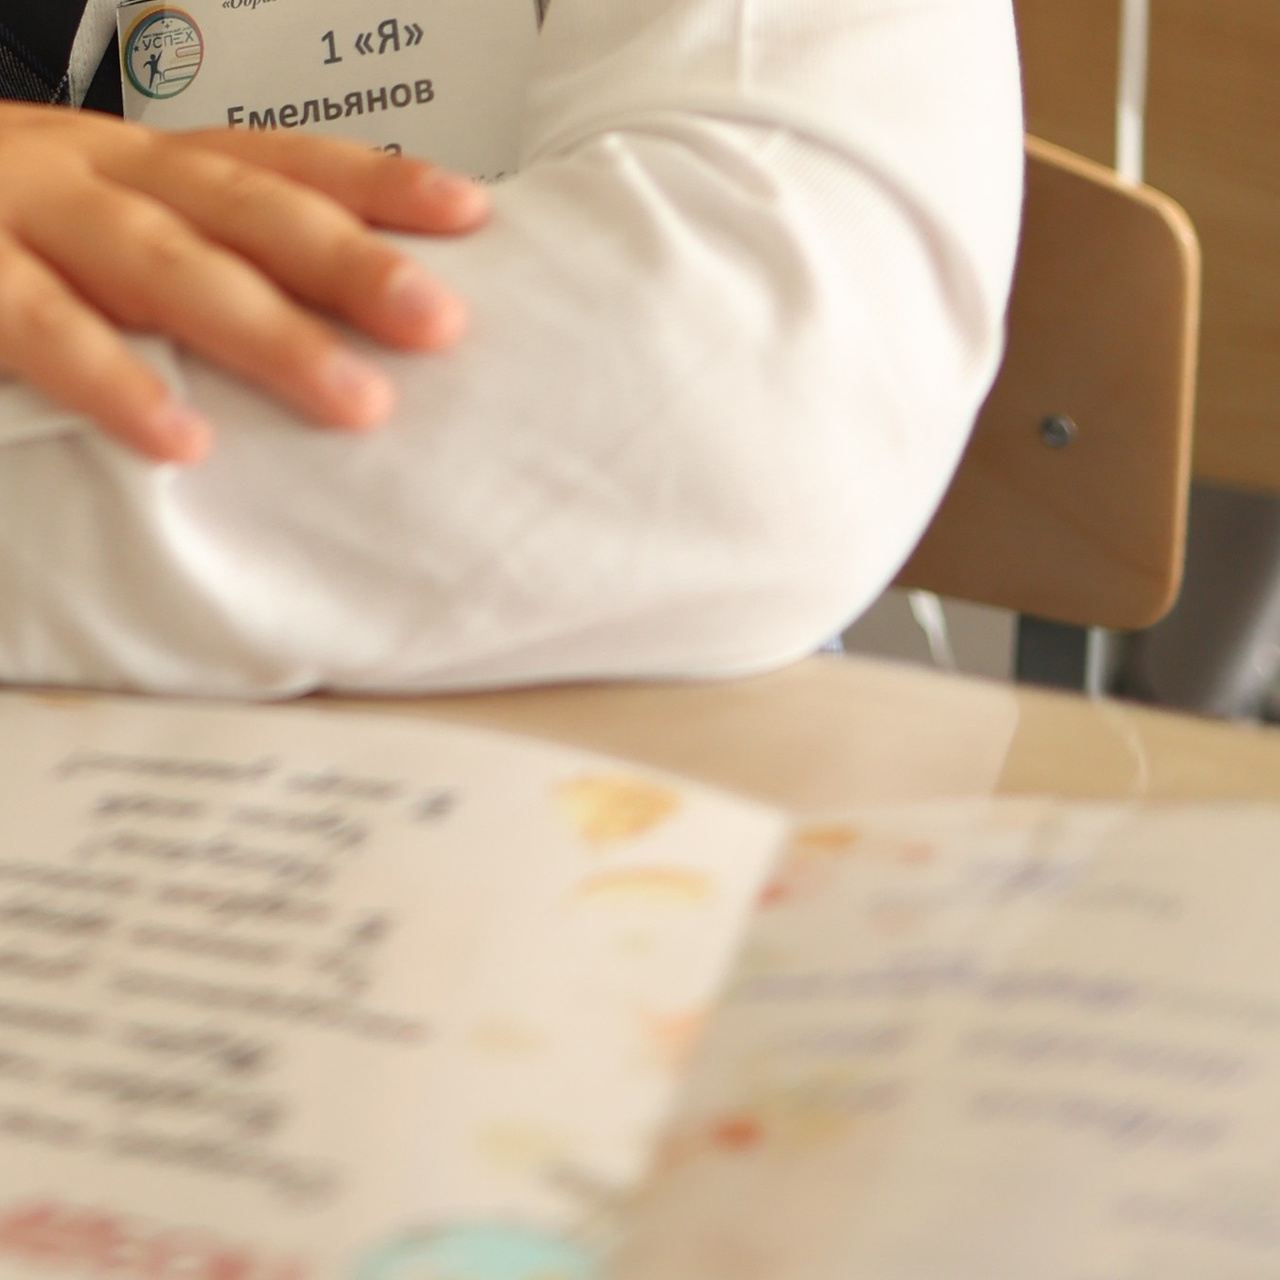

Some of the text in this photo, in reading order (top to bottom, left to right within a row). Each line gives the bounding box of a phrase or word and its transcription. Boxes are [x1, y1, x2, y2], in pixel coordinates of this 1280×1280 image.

[141, 29, 195, 51] УСПЕХ
[320, 18, 425, 65] 1 «Я»
[226, 78, 436, 133] Емельянов
